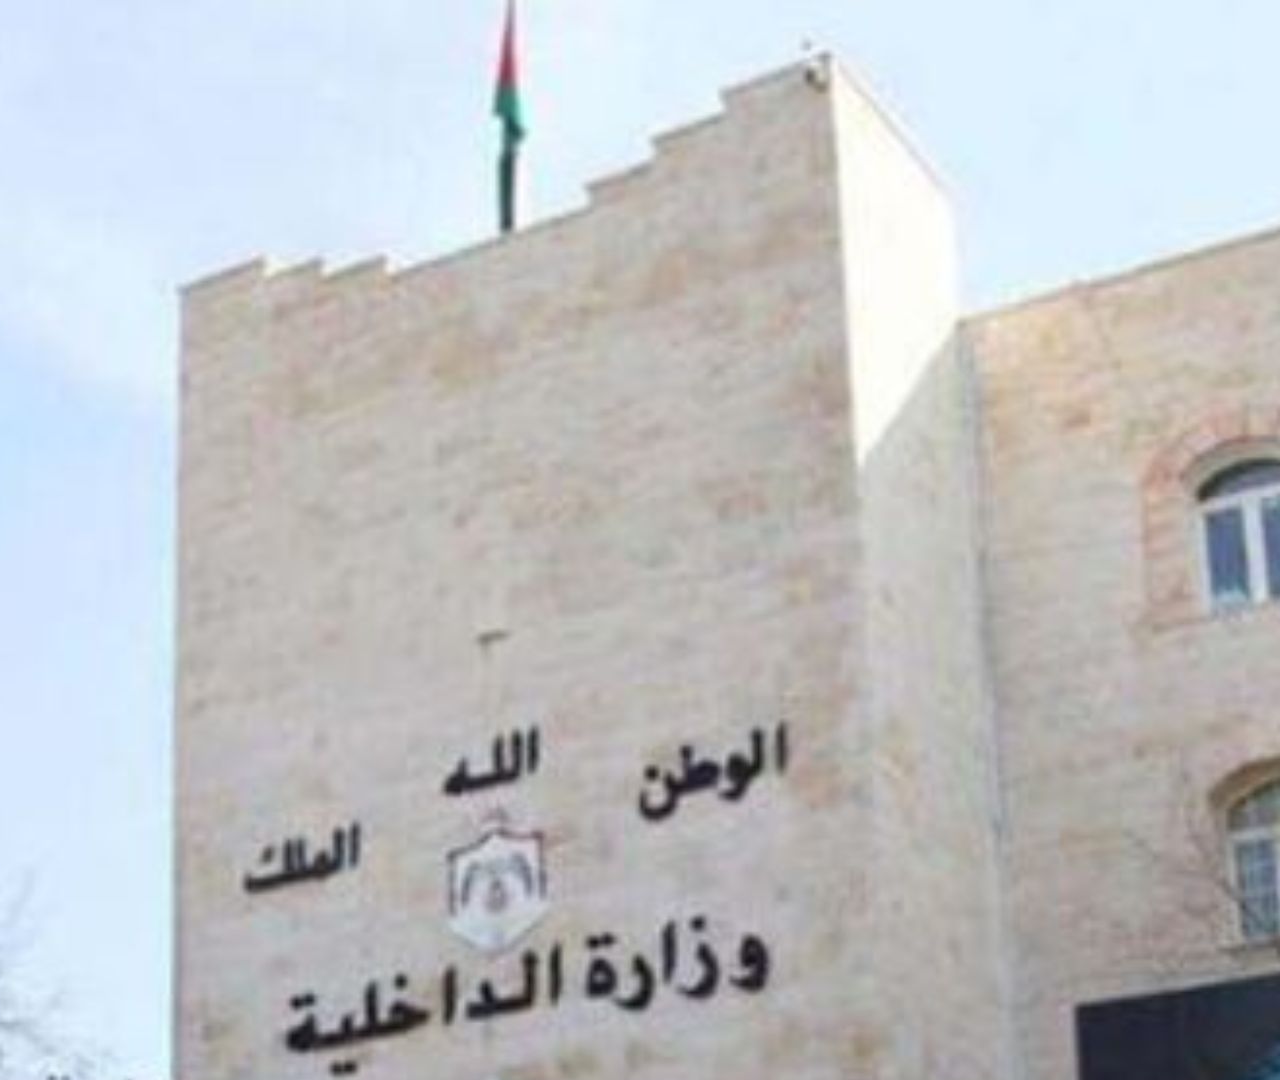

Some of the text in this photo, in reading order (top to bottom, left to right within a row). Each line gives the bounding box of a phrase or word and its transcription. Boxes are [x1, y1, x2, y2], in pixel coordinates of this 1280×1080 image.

[442, 726, 541, 798] الله
[637, 722, 790, 823] الوطن
[242, 822, 362, 894] الملك
[283, 914, 772, 1077] وزارة الداخلية
